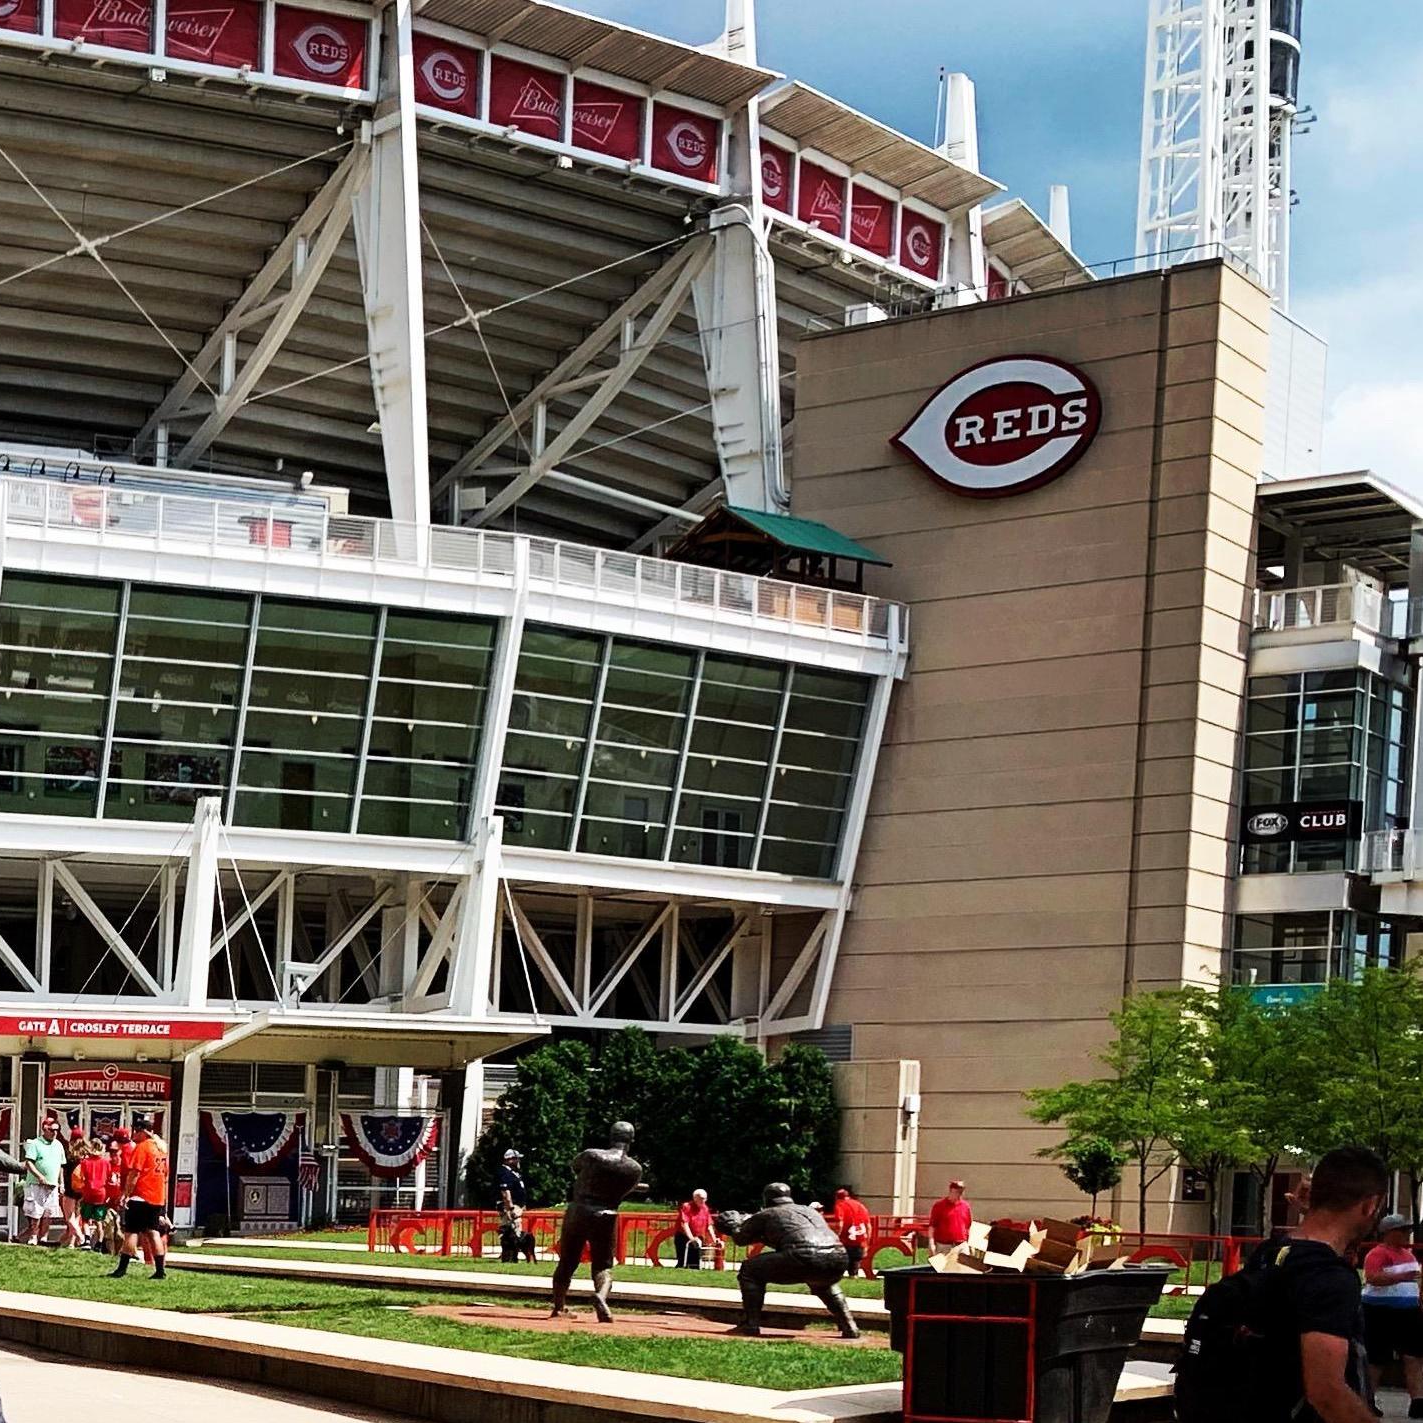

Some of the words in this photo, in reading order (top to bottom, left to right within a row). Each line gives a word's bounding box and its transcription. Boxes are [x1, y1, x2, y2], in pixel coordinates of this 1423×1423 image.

[309, 44, 349, 60] REDS
[435, 66, 466, 88] REDS
[678, 136, 706, 155] REDS
[954, 397, 1088, 448] REDS
[1299, 813, 1347, 828] CLUB
[18, 1020, 46, 1033] GATE
[47, 1018, 61, 1035] A
[69, 1021, 120, 1034] CROSLEY
[121, 1022, 171, 1035] TERRACE
[54, 1079, 84, 1091] SEASON
[85, 1079, 110, 1092] TICKET
[111, 1080, 145, 1093] MEMBER
[146, 1081, 166, 1093] GATE
